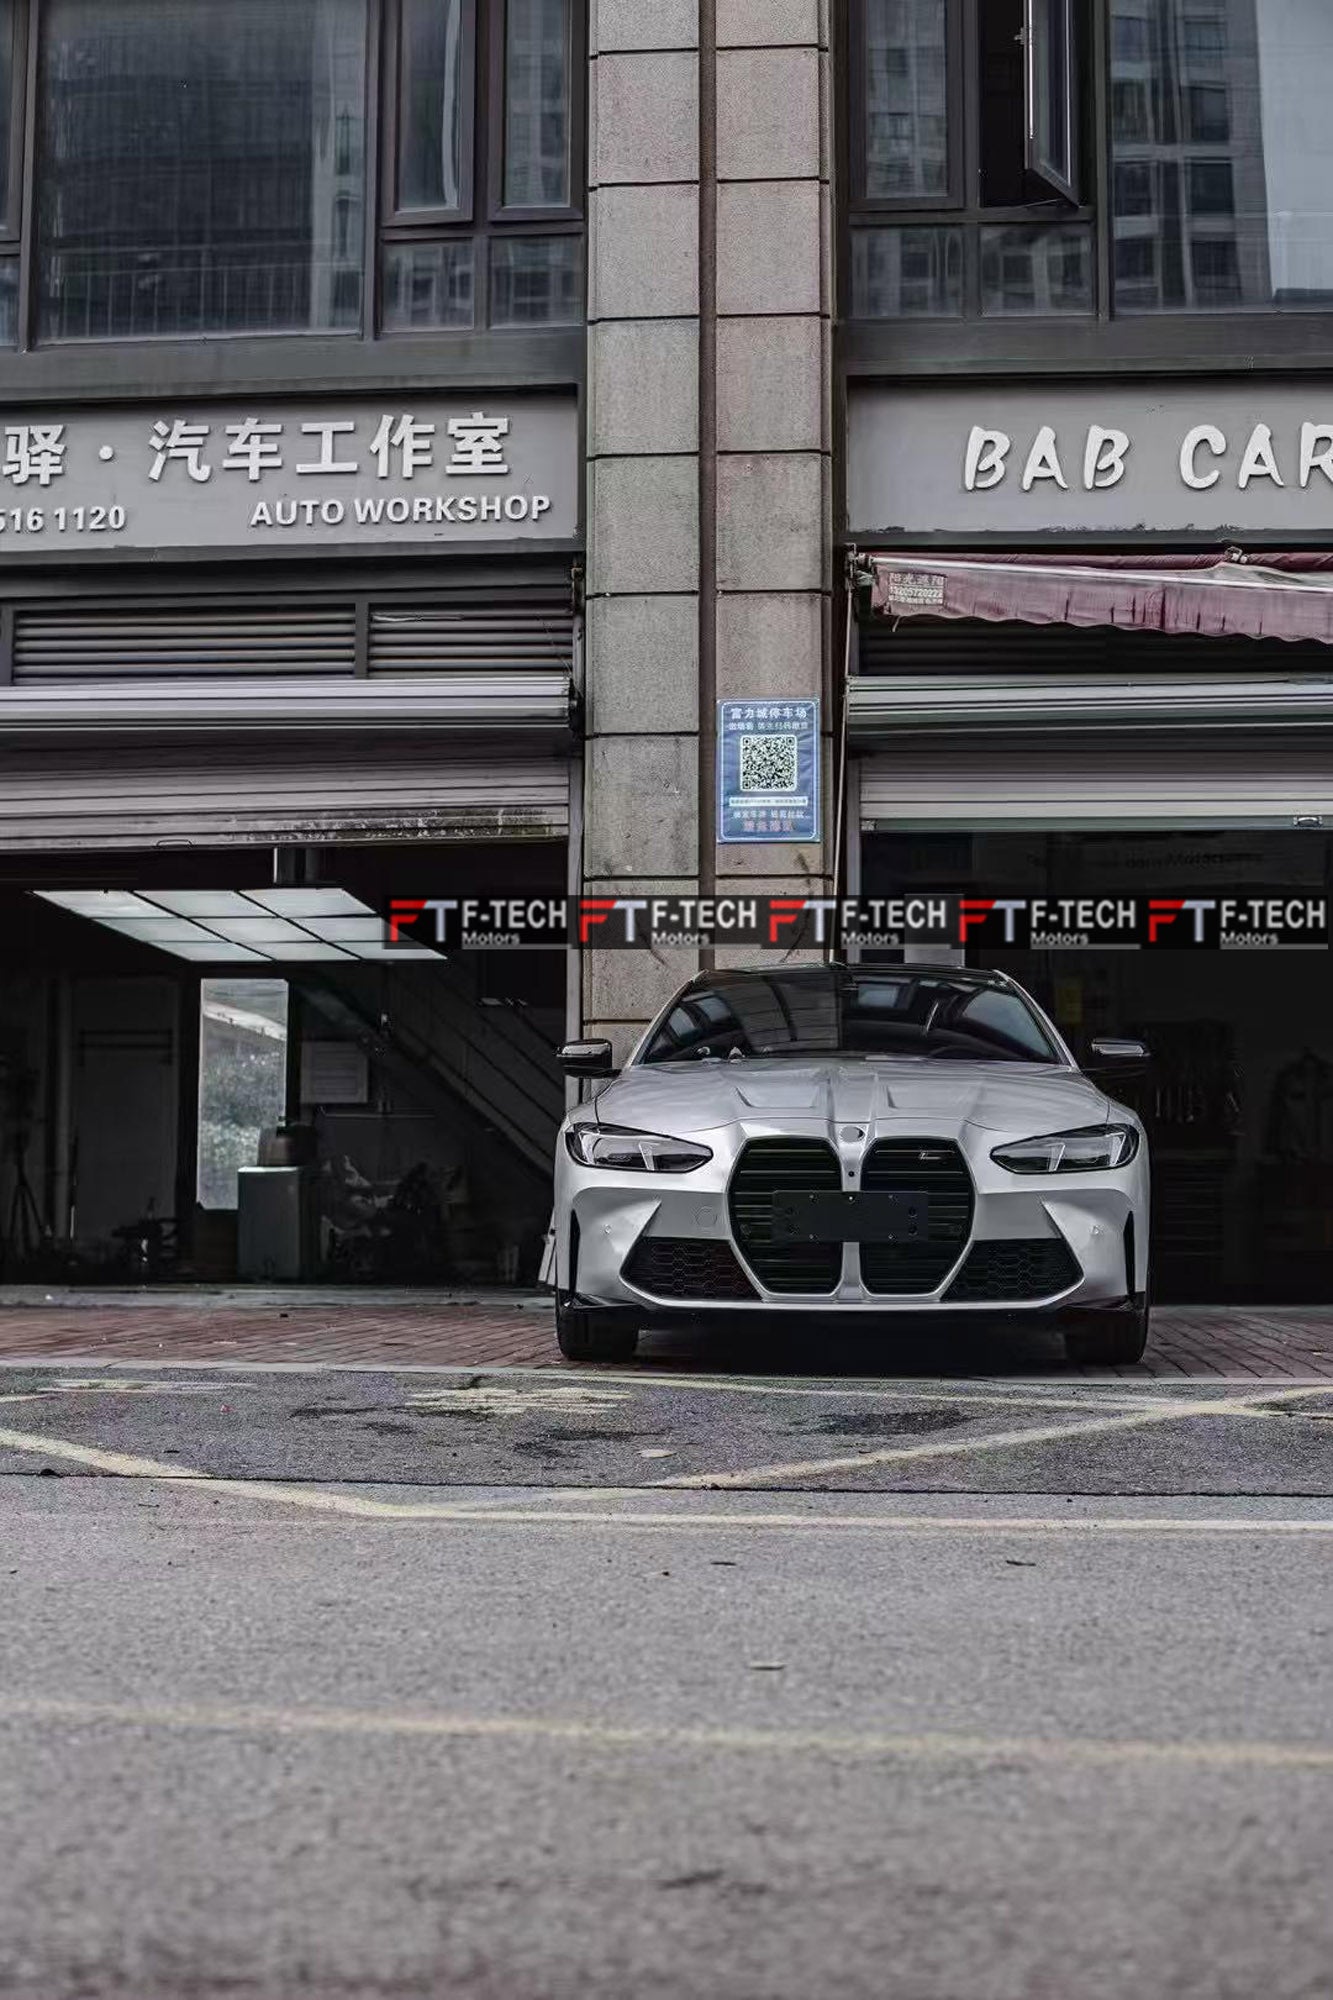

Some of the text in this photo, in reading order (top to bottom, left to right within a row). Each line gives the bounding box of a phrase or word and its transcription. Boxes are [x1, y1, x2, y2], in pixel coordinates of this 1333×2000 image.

[963, 424, 1130, 491] BAB
[54, 505, 126, 531] 1120
[250, 494, 551, 526] AUTO WORKSHOP
